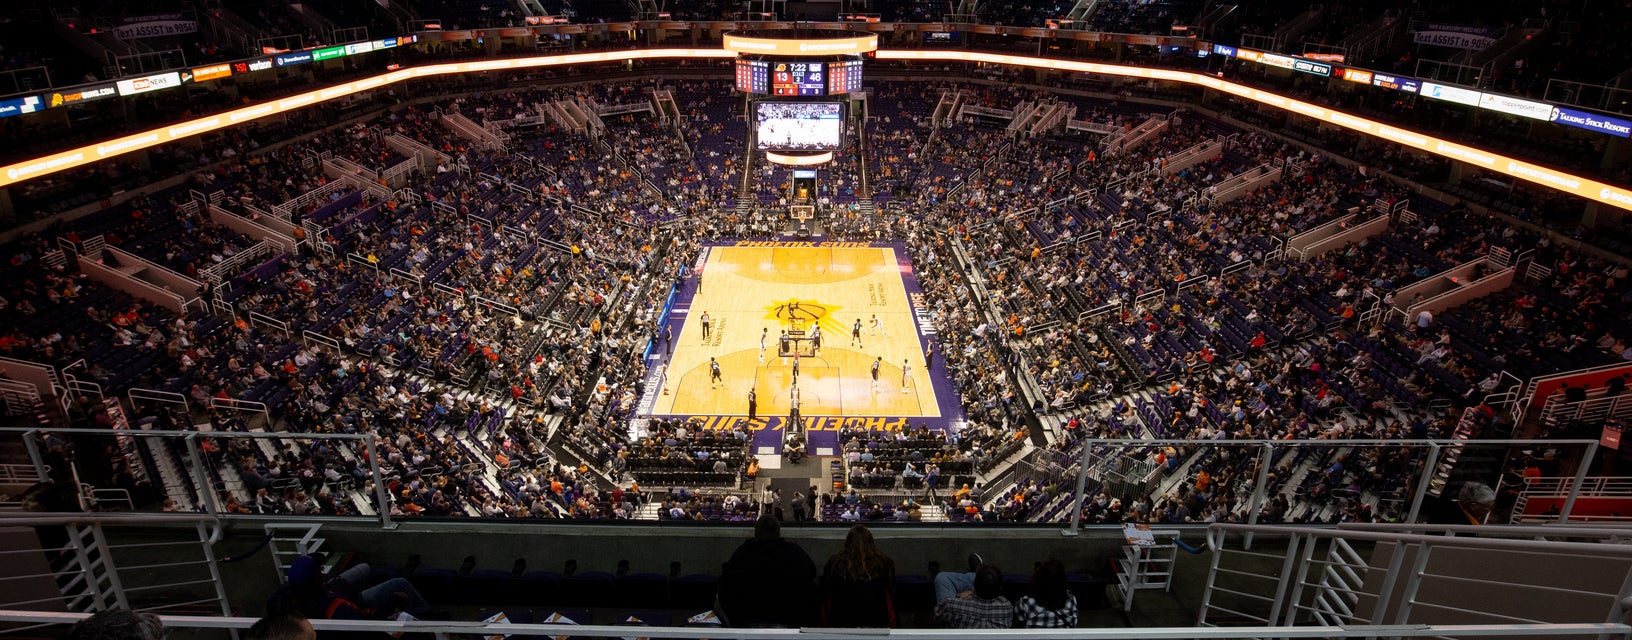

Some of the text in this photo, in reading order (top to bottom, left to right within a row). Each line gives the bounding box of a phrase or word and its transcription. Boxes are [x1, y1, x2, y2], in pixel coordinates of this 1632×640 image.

[117, 28, 135, 38] Text
[136, 25, 164, 36] ASSIST
[165, 25, 173, 33] to
[1416, 33, 1431, 42] Text
[1432, 35, 1460, 46] ASSIST
[1462, 37, 1469, 47] to
[249, 59, 272, 72] verizon
[790, 63, 806, 72] 7:22
[150, 77, 167, 86] NEWS
[777, 73, 788, 82] 13
[809, 73, 821, 82] 46
[1501, 100, 1549, 113] copperpoint.com
[735, 240, 818, 248] PHOENIX
